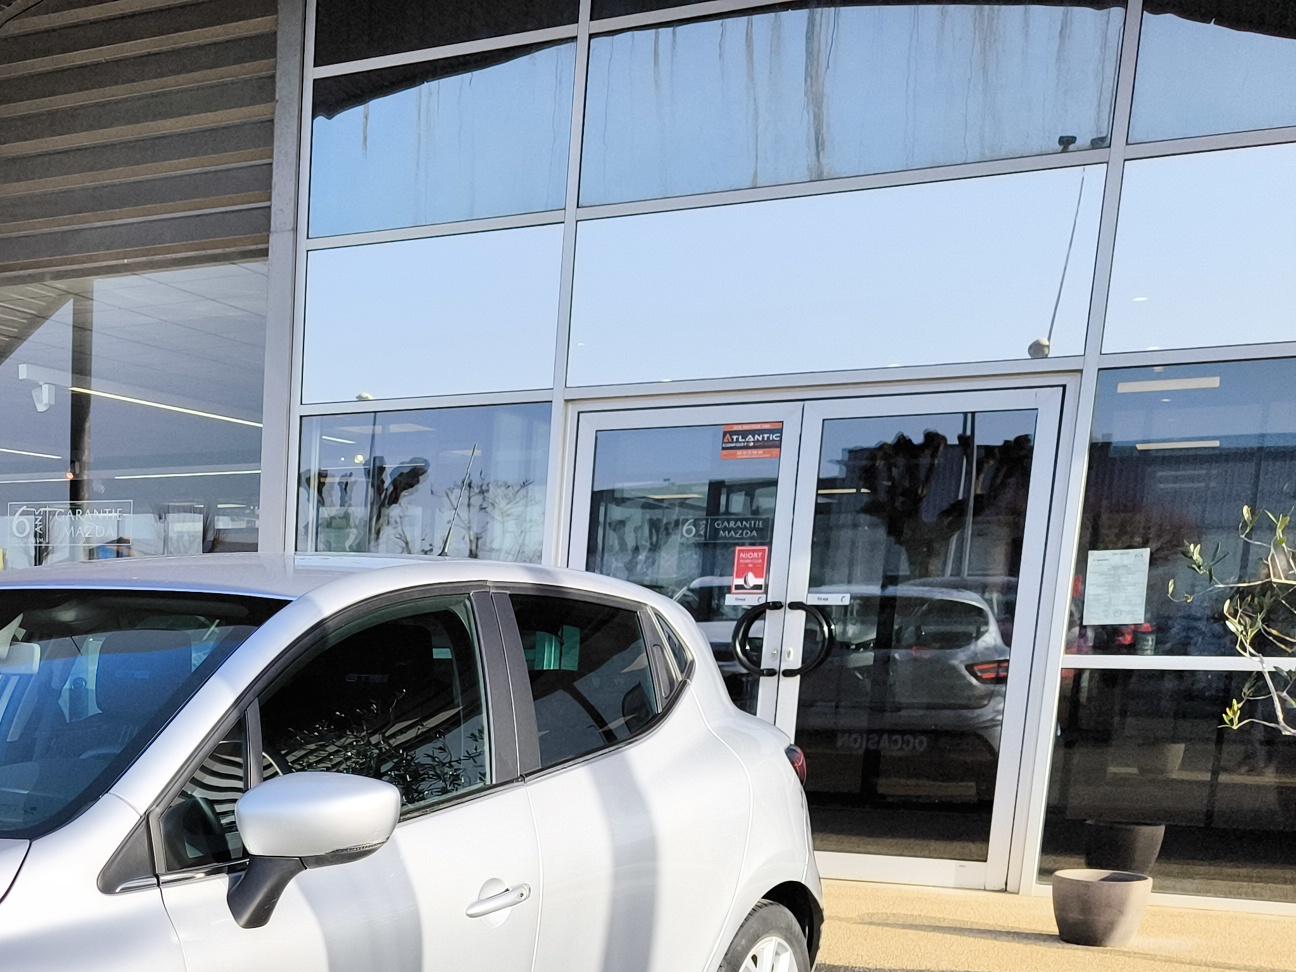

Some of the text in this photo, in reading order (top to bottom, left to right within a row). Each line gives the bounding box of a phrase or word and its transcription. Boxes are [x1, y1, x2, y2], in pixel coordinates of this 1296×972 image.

[723, 433, 781, 442] ATLANTIC
[55, 507, 123, 521] GARANTIE
[12, 506, 30, 538] 6
[683, 519, 696, 538] 6
[714, 520, 763, 529] GARANTIE
[65, 525, 114, 538] MAZDA
[719, 530, 758, 538] MAZDA
